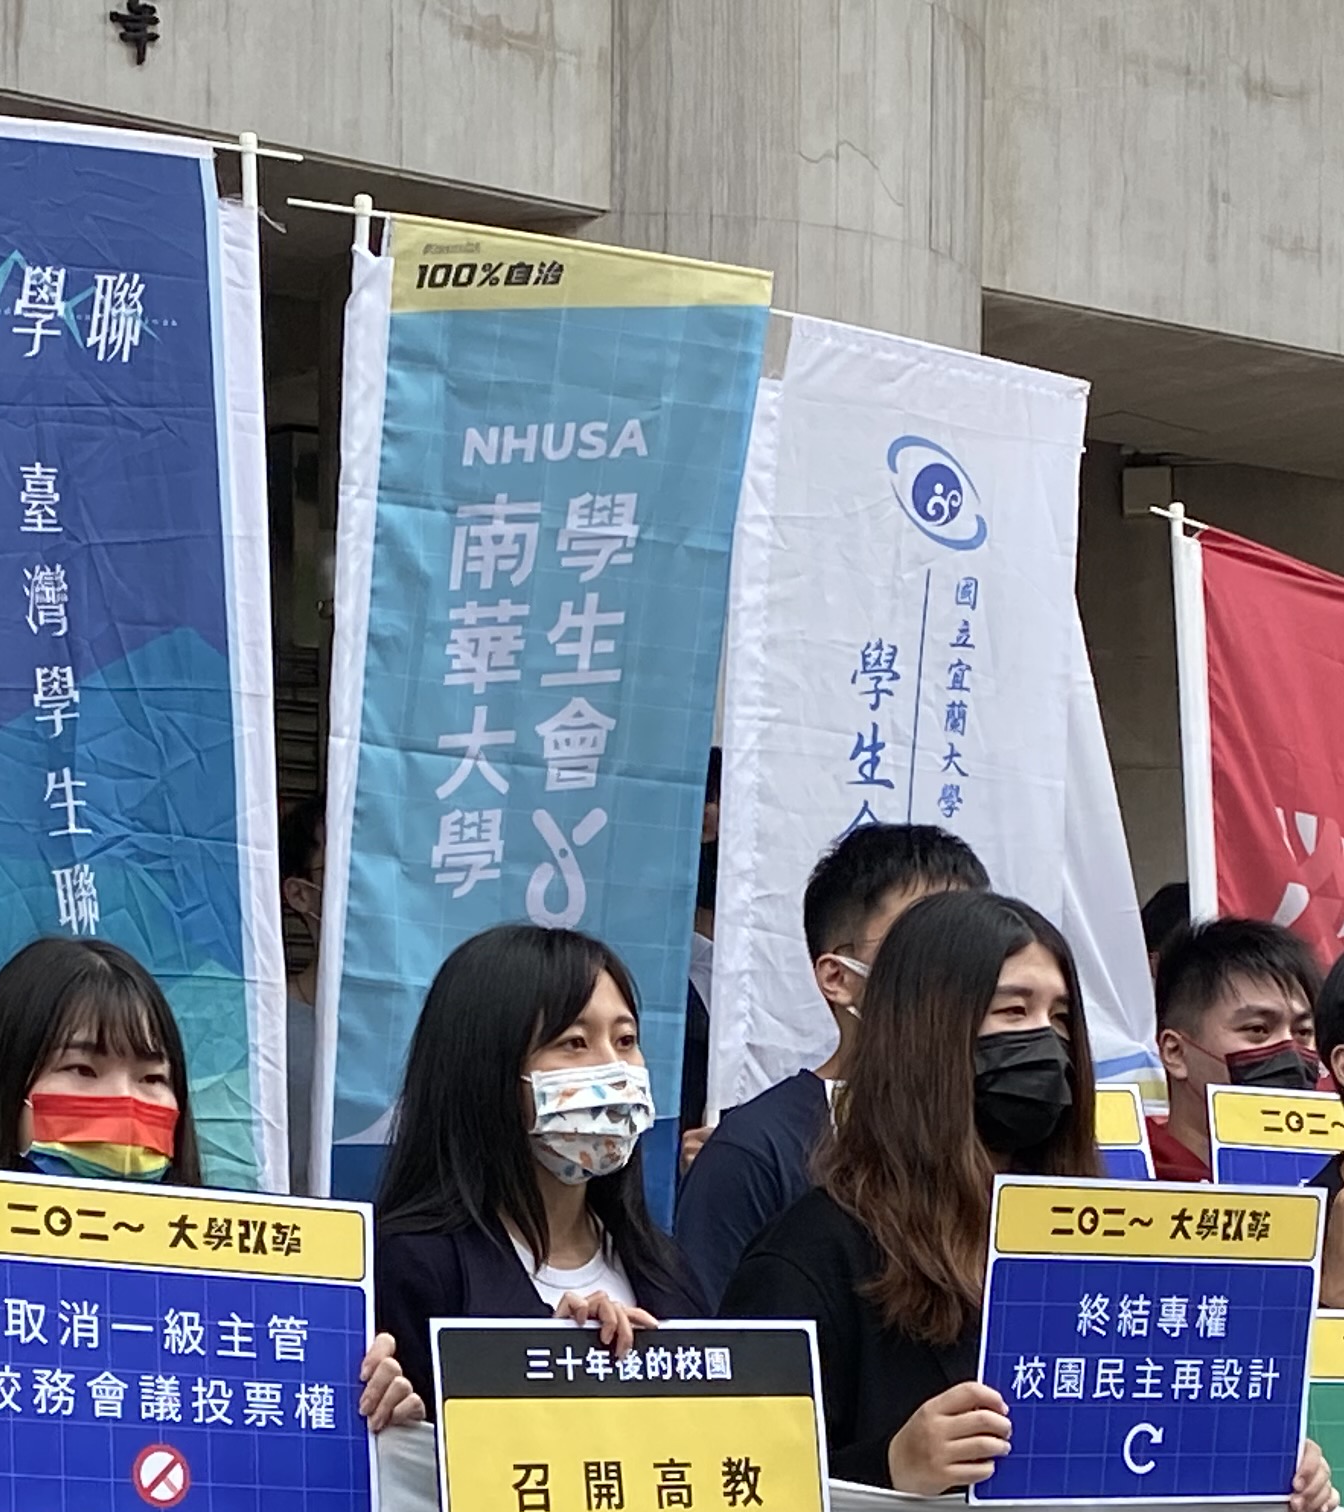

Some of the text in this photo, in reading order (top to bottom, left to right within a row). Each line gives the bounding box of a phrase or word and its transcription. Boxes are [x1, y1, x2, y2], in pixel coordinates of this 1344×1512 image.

[416, 260, 564, 289] 100%自治
[462, 419, 649, 467] NHUSA
[534, 492, 640, 792] 學生會
[431, 493, 542, 898] 南華大學
[937, 575, 979, 819] 國立宜蘭大學
[167, 1215, 302, 1257] 大學改革
[1169, 1207, 1271, 1242] 大學改革
[3, 1297, 310, 1363] 取消一級主管
[1076, 1293, 1230, 1339] 終結專權
[525, 1346, 733, 1383] 三十年後的校園
[1010, 1355, 1281, 1401] 校園民主再設計
